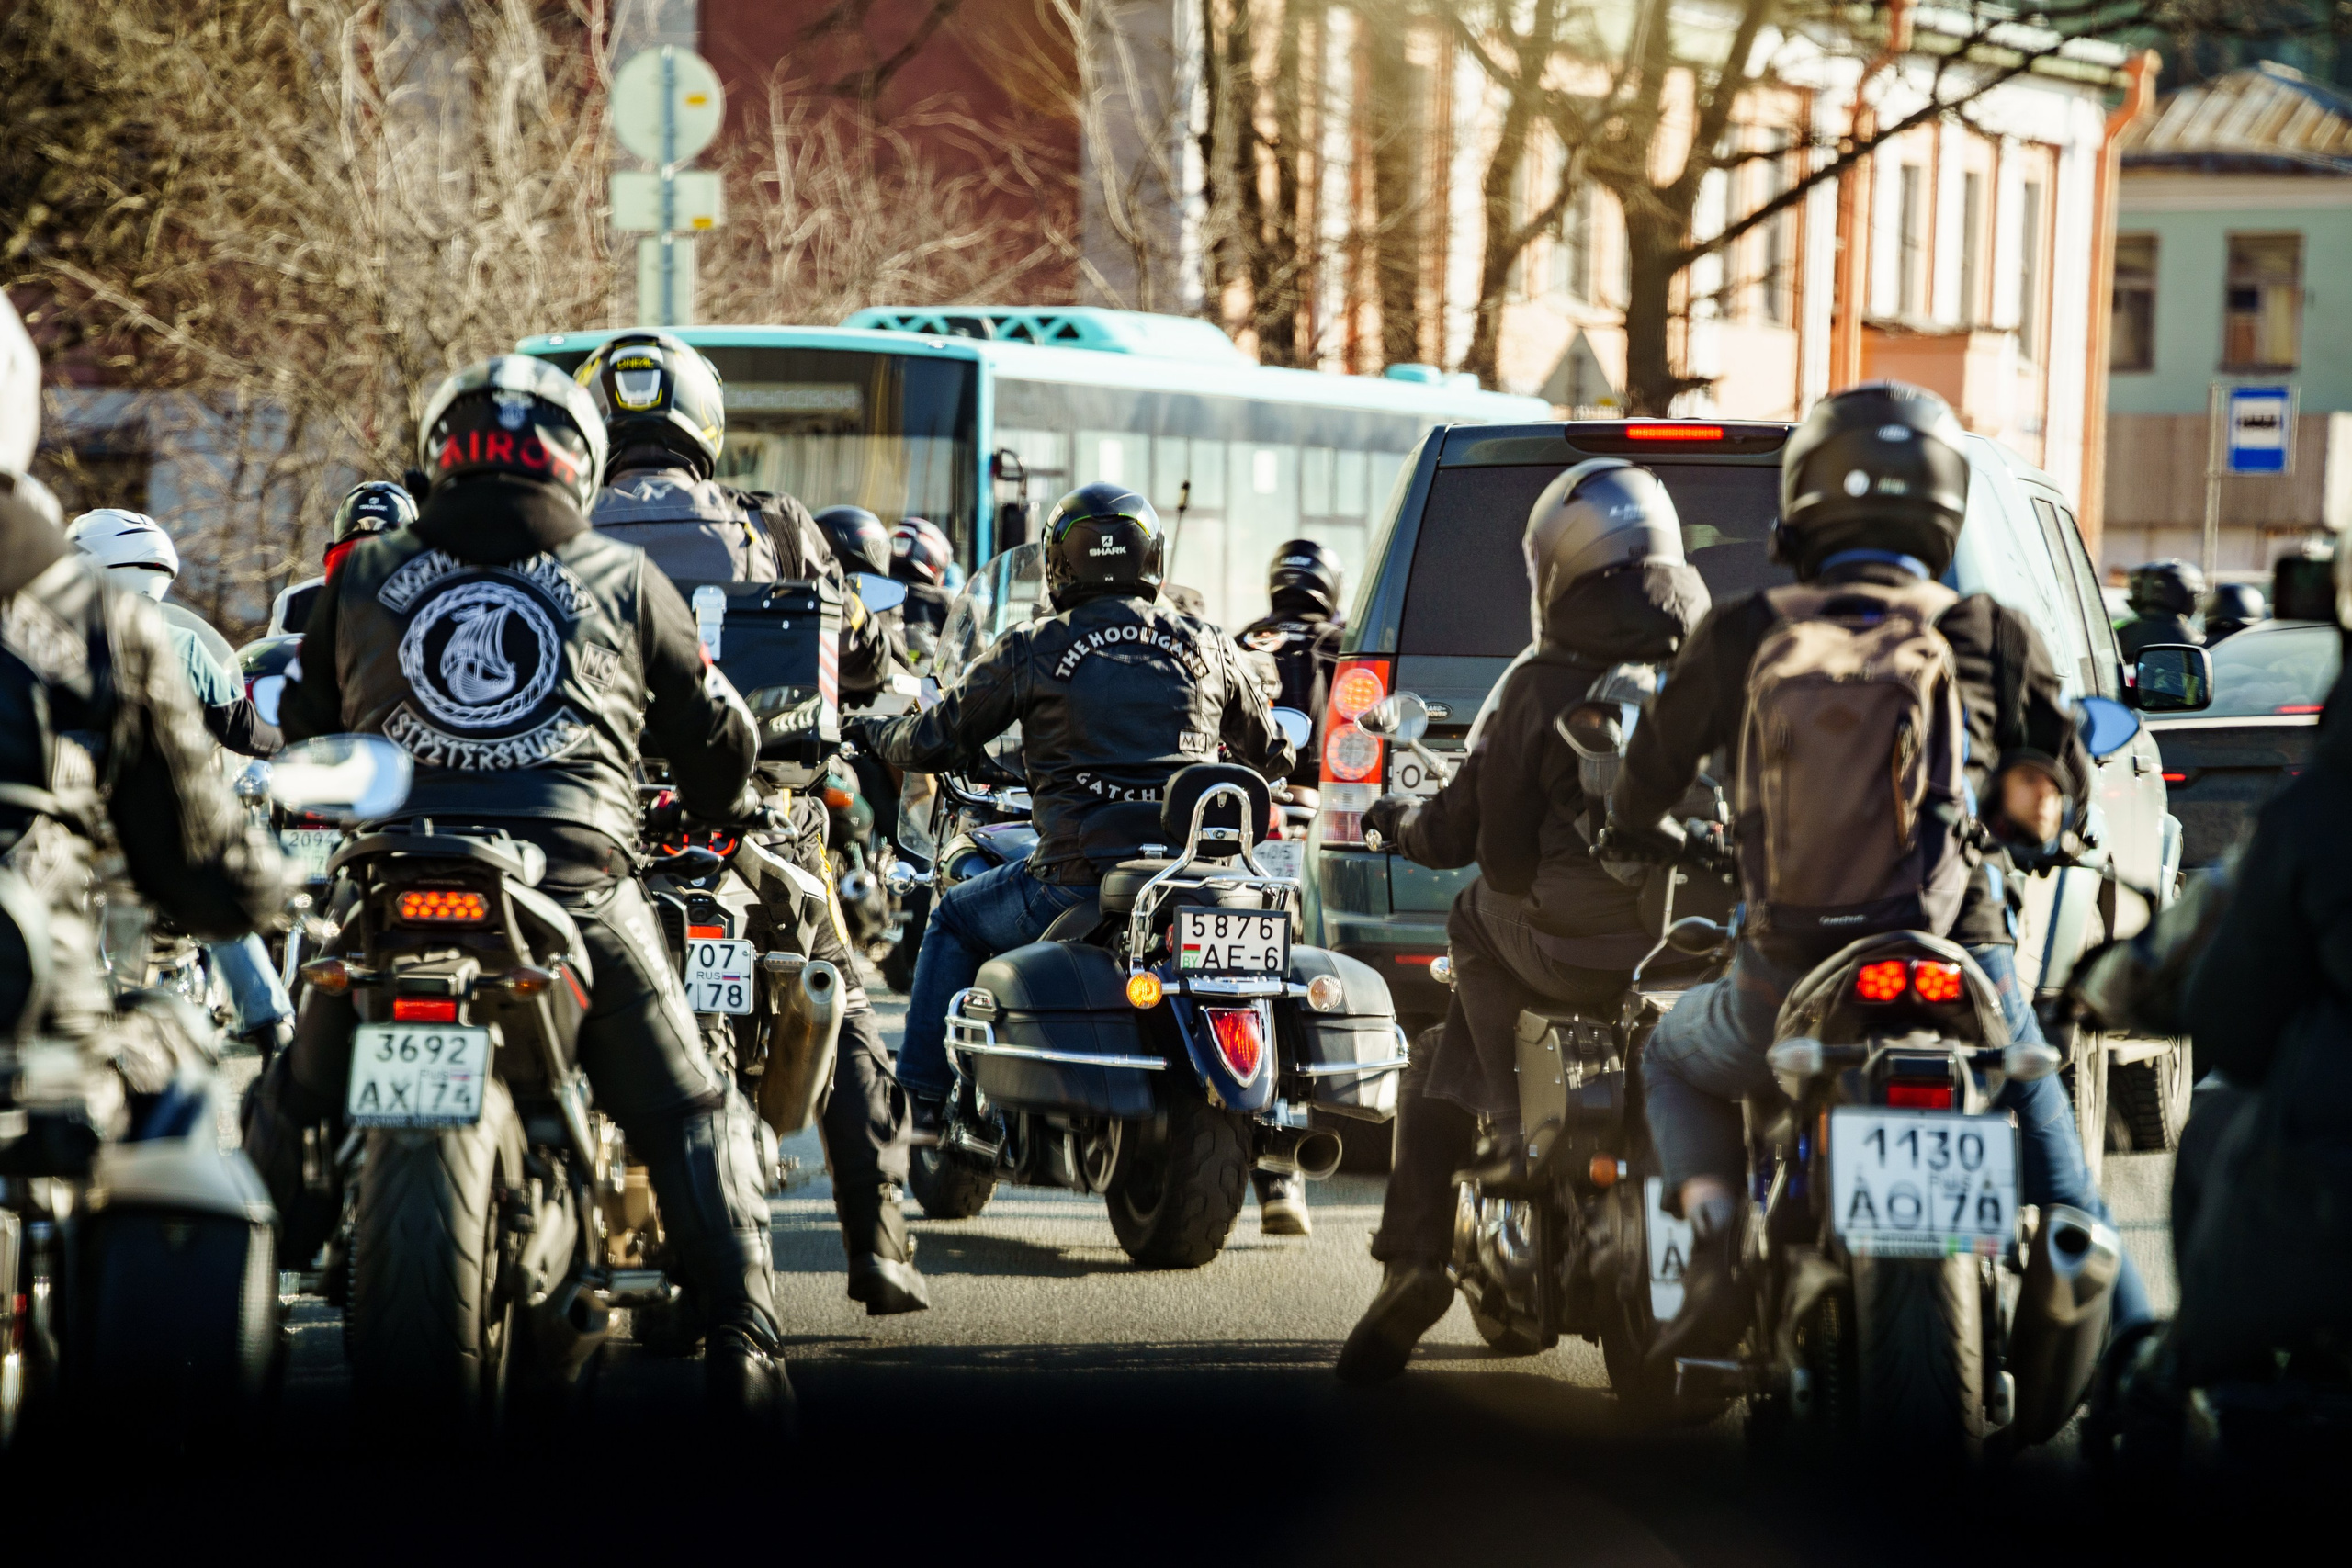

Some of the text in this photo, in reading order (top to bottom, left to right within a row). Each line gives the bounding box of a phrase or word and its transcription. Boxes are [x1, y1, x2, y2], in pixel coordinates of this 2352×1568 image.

[1089, 546, 1127, 558] SHARK
[1055, 625, 1208, 679] THE HOOLIGANS
[1076, 773, 1166, 802] GATCH
[1192, 913, 1273, 940] 5876
[1182, 943, 1279, 971] BY AE-6
[696, 971, 721, 980] RUS
[706, 984, 743, 1009] 78
[375, 1034, 467, 1065] 3692
[356, 1080, 411, 1112] AX
[1863, 1127, 1984, 1172] 1130
